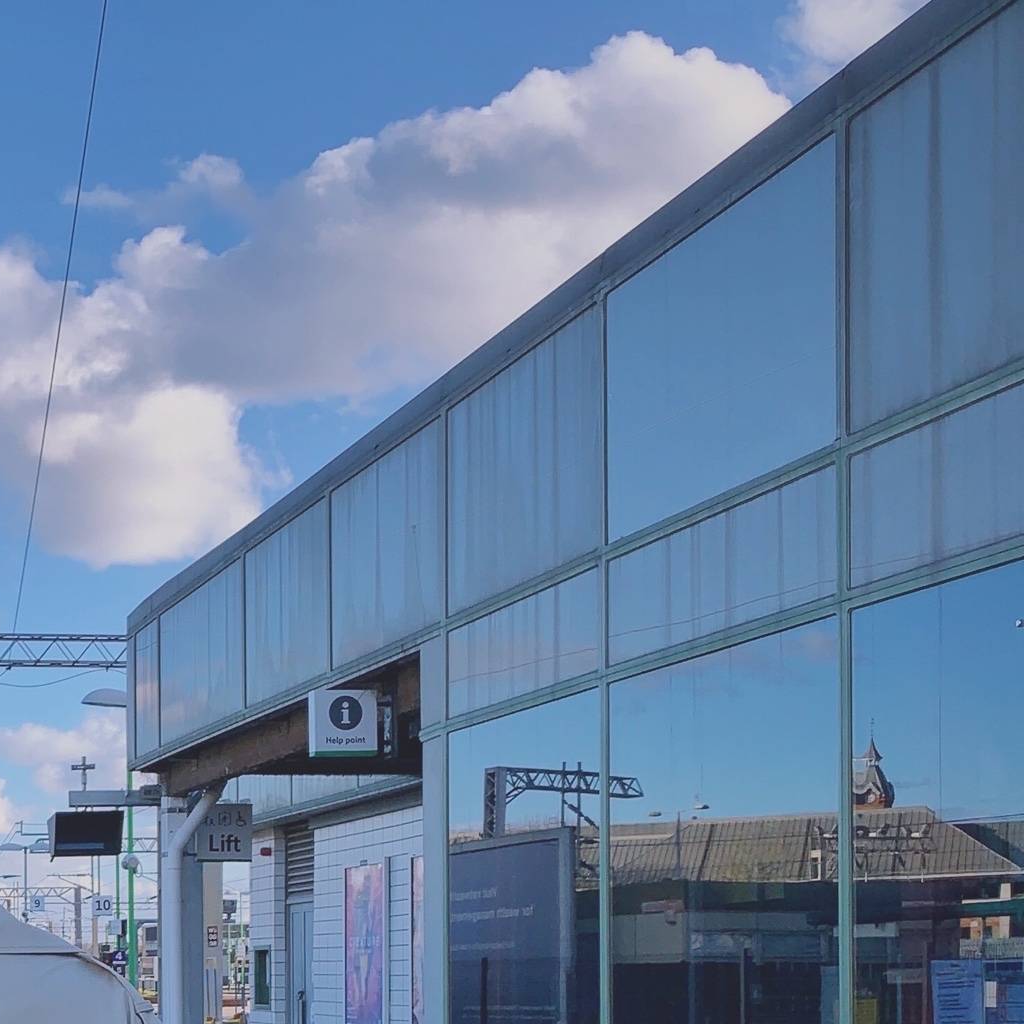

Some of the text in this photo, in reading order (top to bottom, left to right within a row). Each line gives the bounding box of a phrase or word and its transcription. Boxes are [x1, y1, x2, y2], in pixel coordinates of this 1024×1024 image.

[326, 735, 366, 744] Help point
[209, 834, 241, 853] Lift
[34, 899, 41, 908] 9
[95, 899, 111, 911] 10
